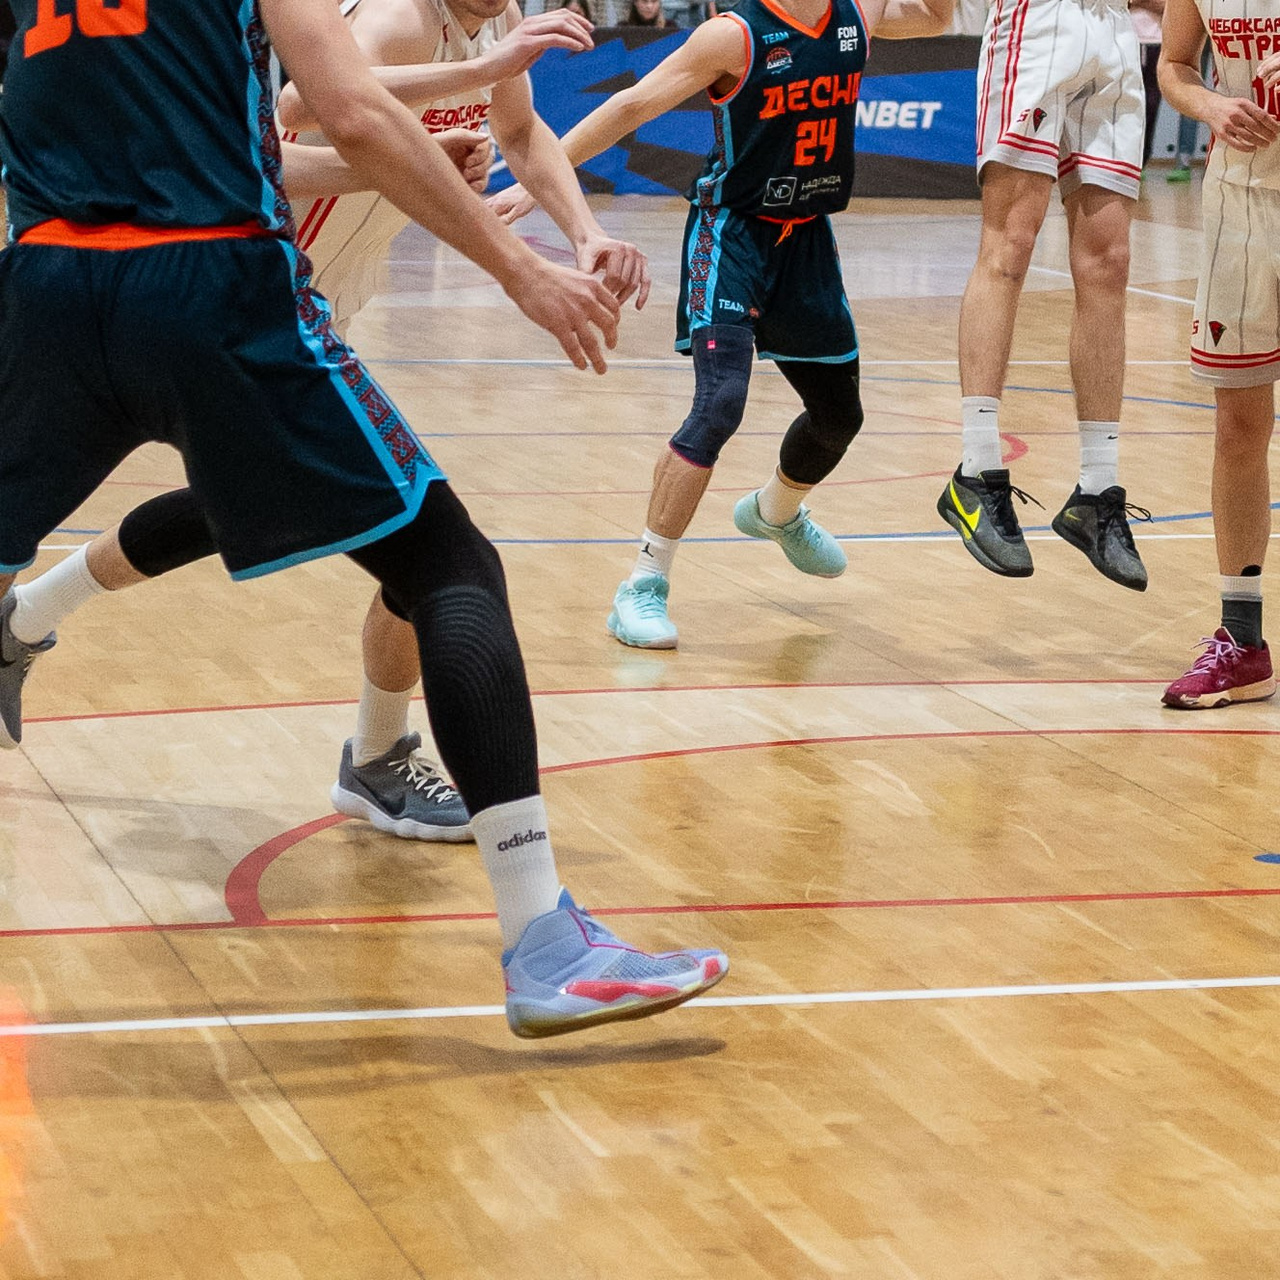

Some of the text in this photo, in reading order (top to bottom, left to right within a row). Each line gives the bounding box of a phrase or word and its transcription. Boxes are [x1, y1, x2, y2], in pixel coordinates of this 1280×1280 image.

[762, 31, 789, 45] TEAM
[837, 26, 857, 39] FON
[839, 38, 859, 52] BET
[794, 118, 838, 166] 24
[497, 829, 547, 852] adidas
